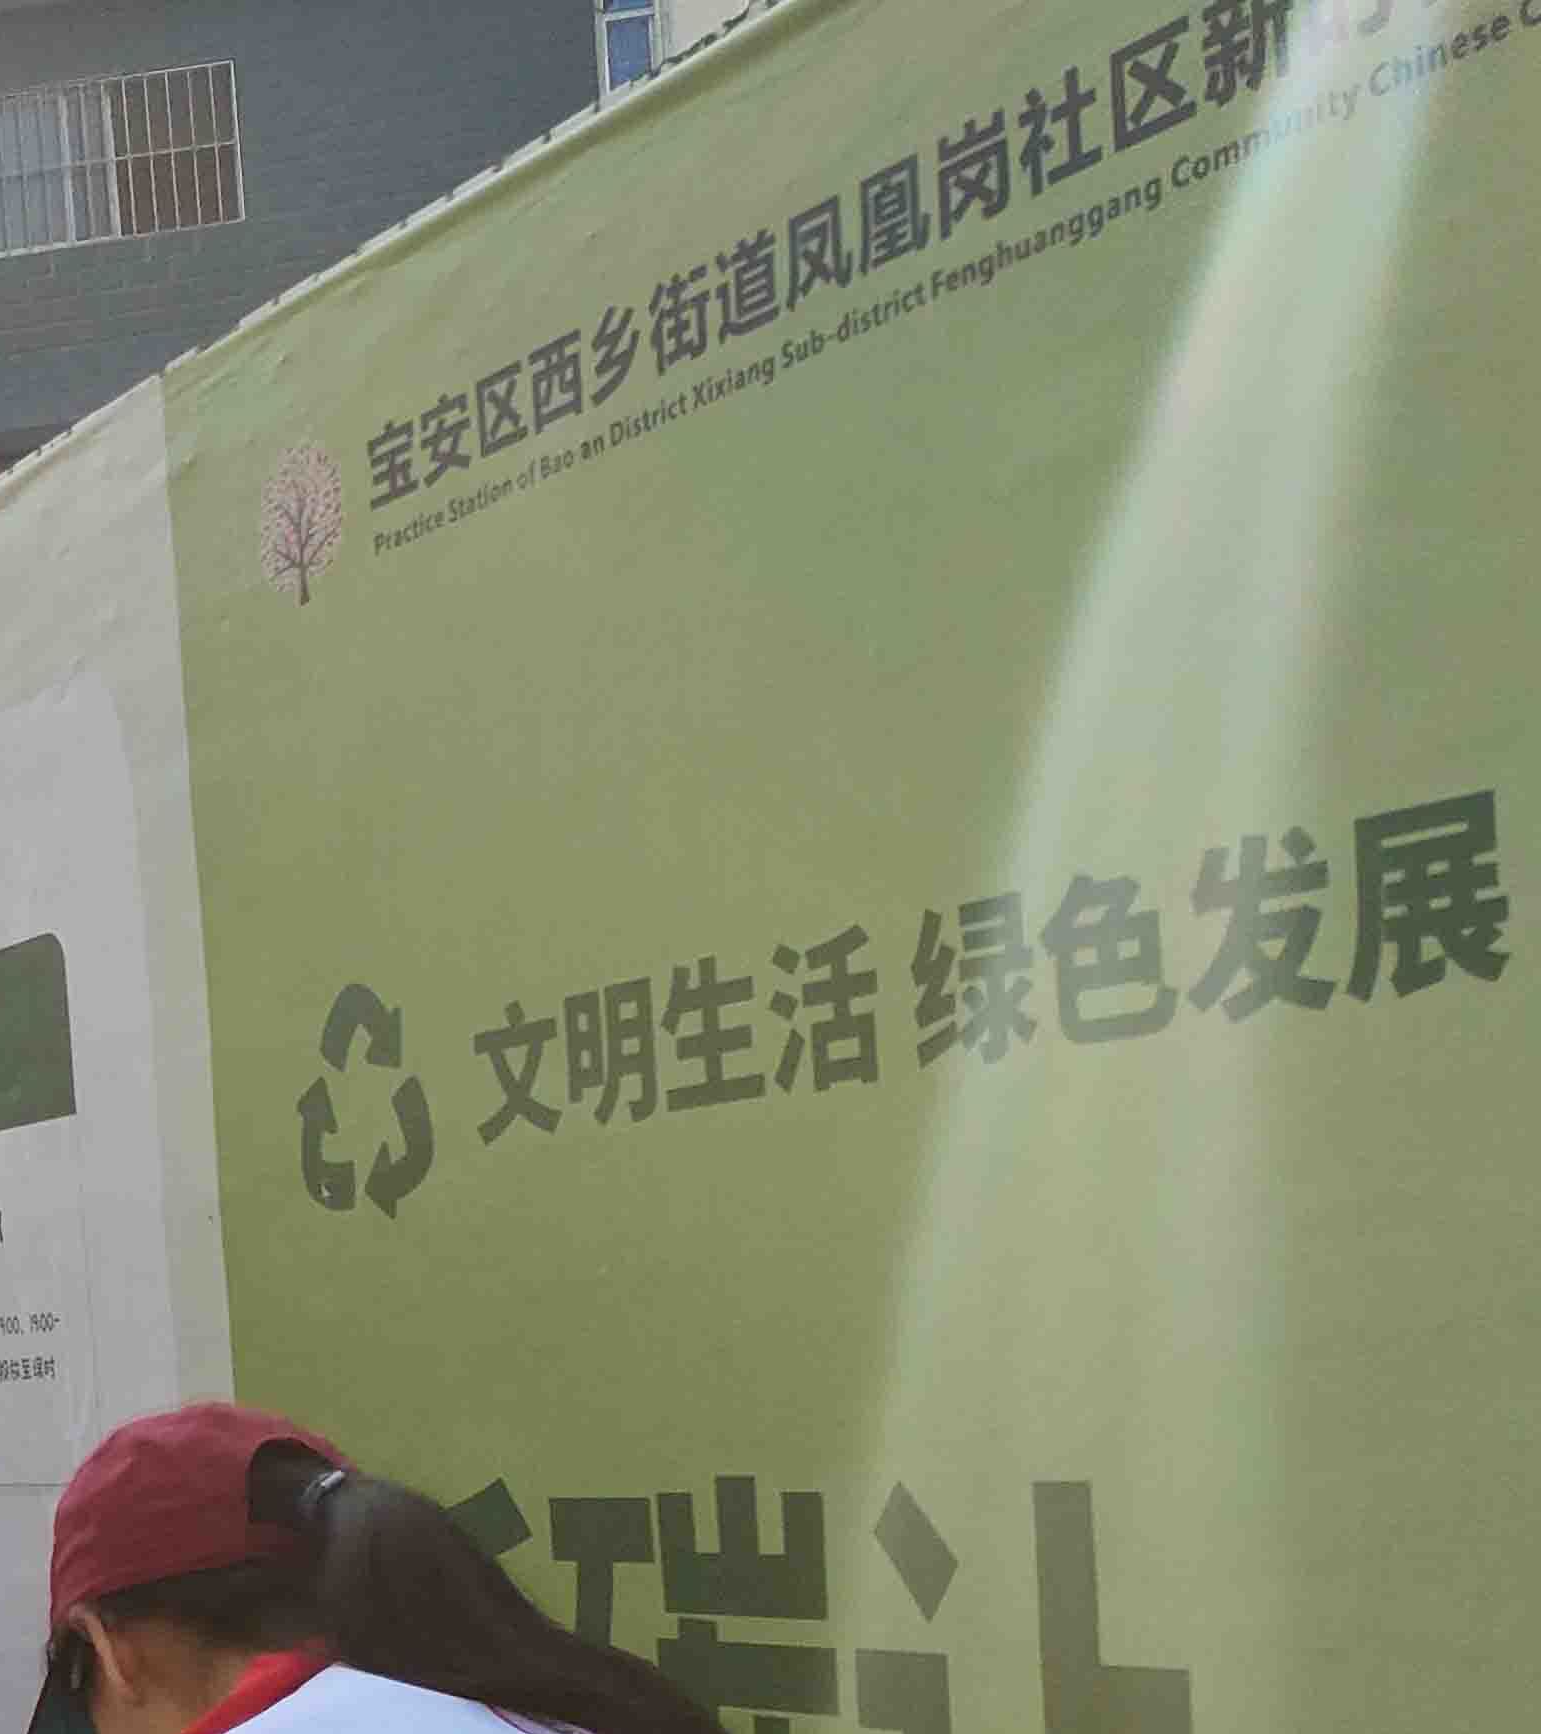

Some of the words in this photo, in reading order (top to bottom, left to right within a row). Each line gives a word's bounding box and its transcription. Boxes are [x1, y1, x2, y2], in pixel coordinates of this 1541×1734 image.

[365, 0, 1367, 509] 宝安区西乡街道凤凰岗社区新
[373, 511, 444, 556] Practice
[448, 474, 514, 523] Station
[516, 457, 537, 490] of
[539, 449, 574, 479] Bao
[579, 435, 606, 462] an
[608, 395, 688, 449] District
[692, 352, 776, 411] Xixiang
[781, 281, 927, 370] Sub-district
[930, 174, 1162, 301] Fenghuanggang
[1369, 15, 1512, 97] Chinese
[472, 923, 880, 1148] 文明生活
[909, 789, 1512, 1065] 绿色发展
